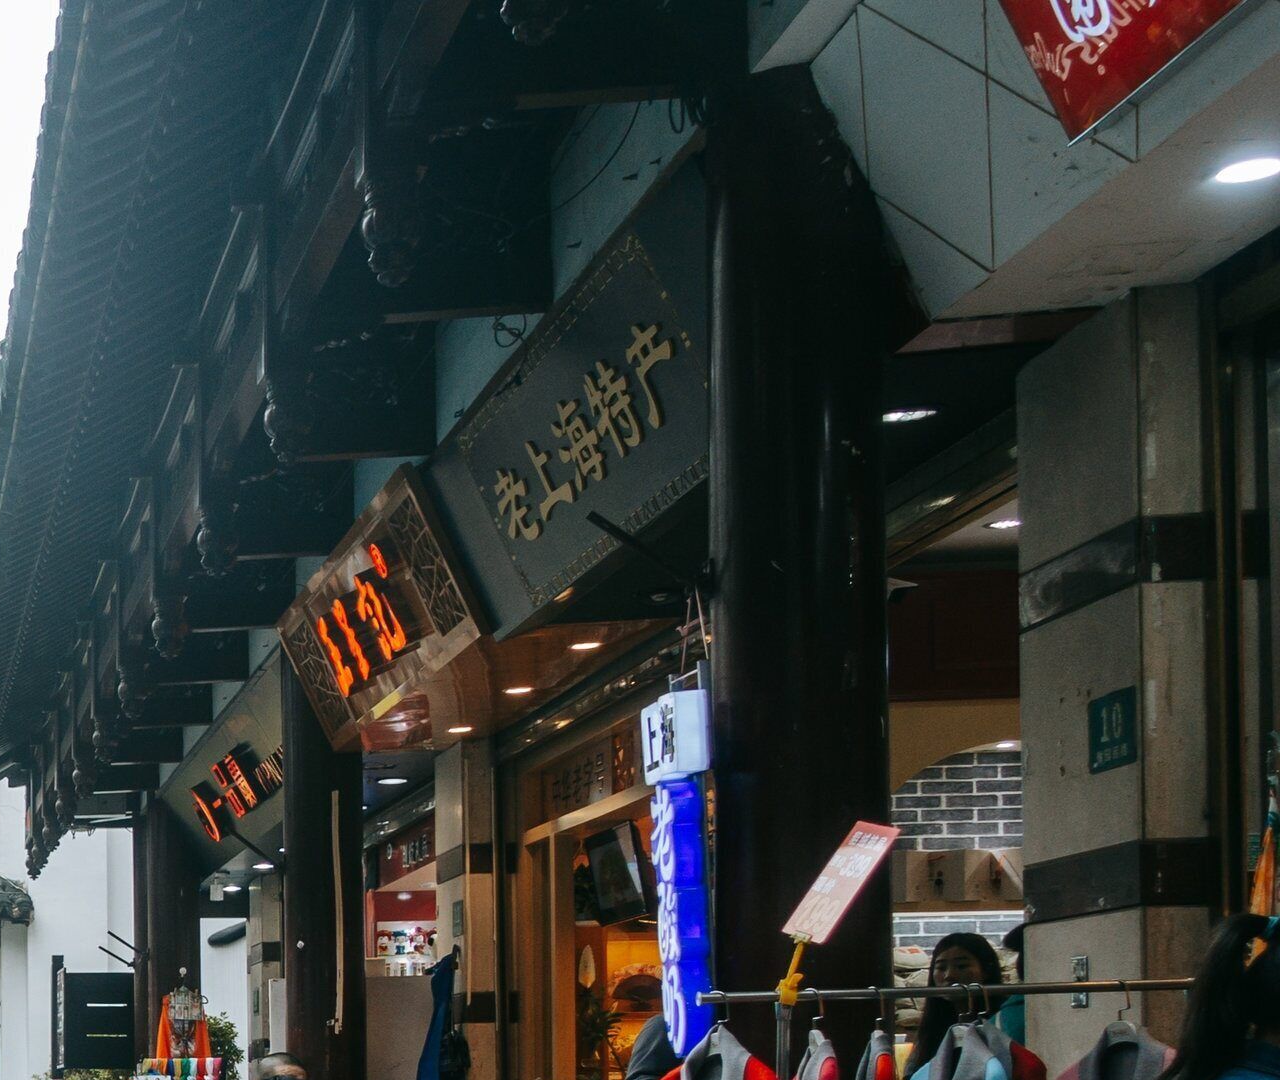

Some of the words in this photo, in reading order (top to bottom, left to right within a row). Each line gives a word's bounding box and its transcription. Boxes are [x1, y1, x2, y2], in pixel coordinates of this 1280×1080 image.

[494, 323, 672, 541] 老上海特产
[646, 703, 675, 773] 上海
[1101, 703, 1123, 742] 10
